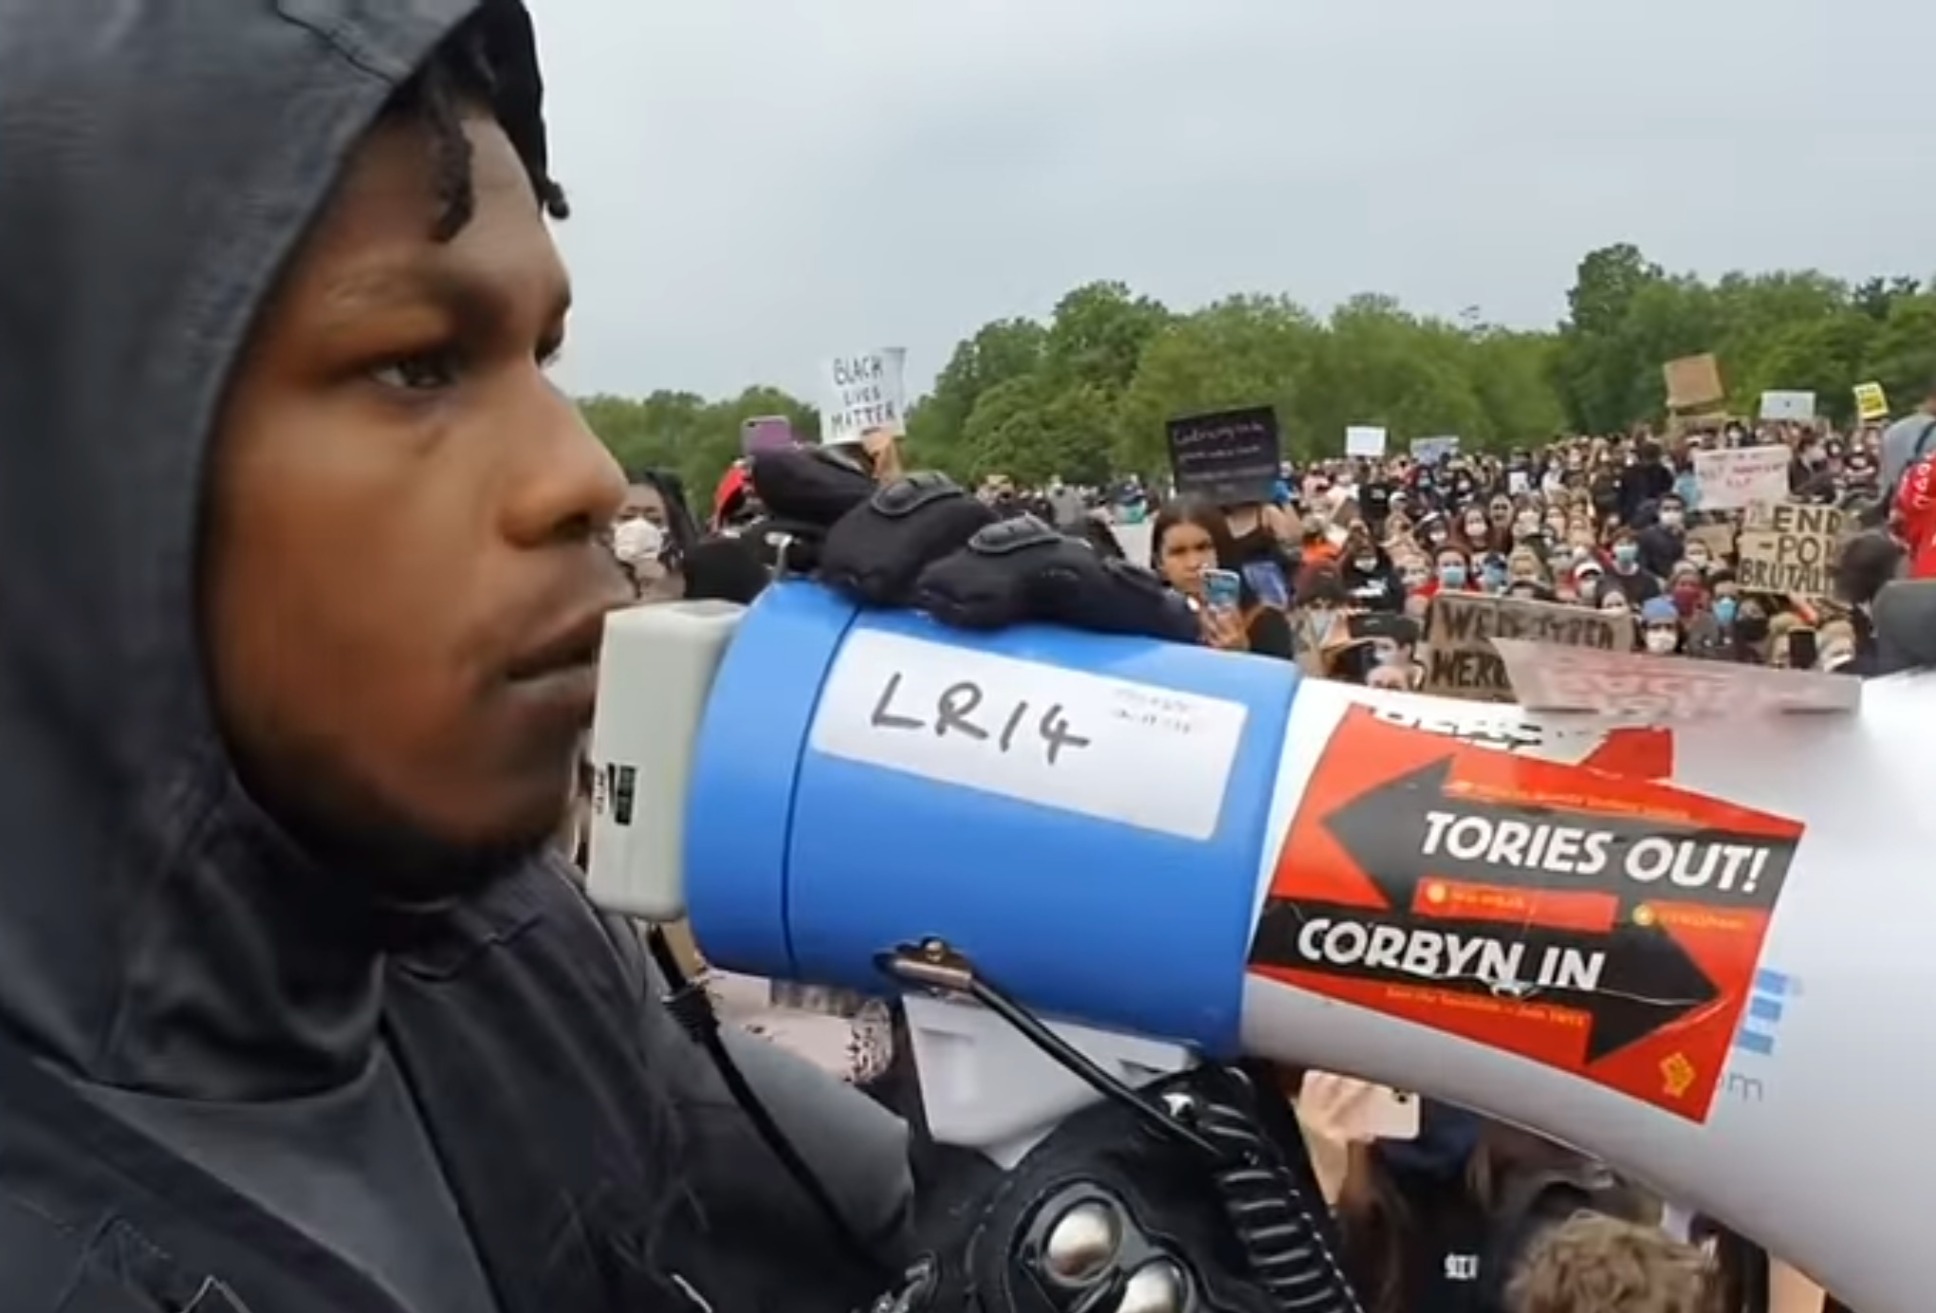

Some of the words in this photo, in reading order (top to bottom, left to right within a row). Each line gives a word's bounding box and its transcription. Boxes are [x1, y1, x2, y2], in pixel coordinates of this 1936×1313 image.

[834, 356, 883, 385] BLACK
[830, 400, 897, 437] MATTER
[1773, 505, 1842, 535] END
[871, 671, 1092, 765] LR14
[1421, 811, 1613, 875] TORIES
[1624, 838, 1770, 893] OUT!
[1297, 917, 1526, 983] CORBYN
[1537, 945, 1607, 991] IN
